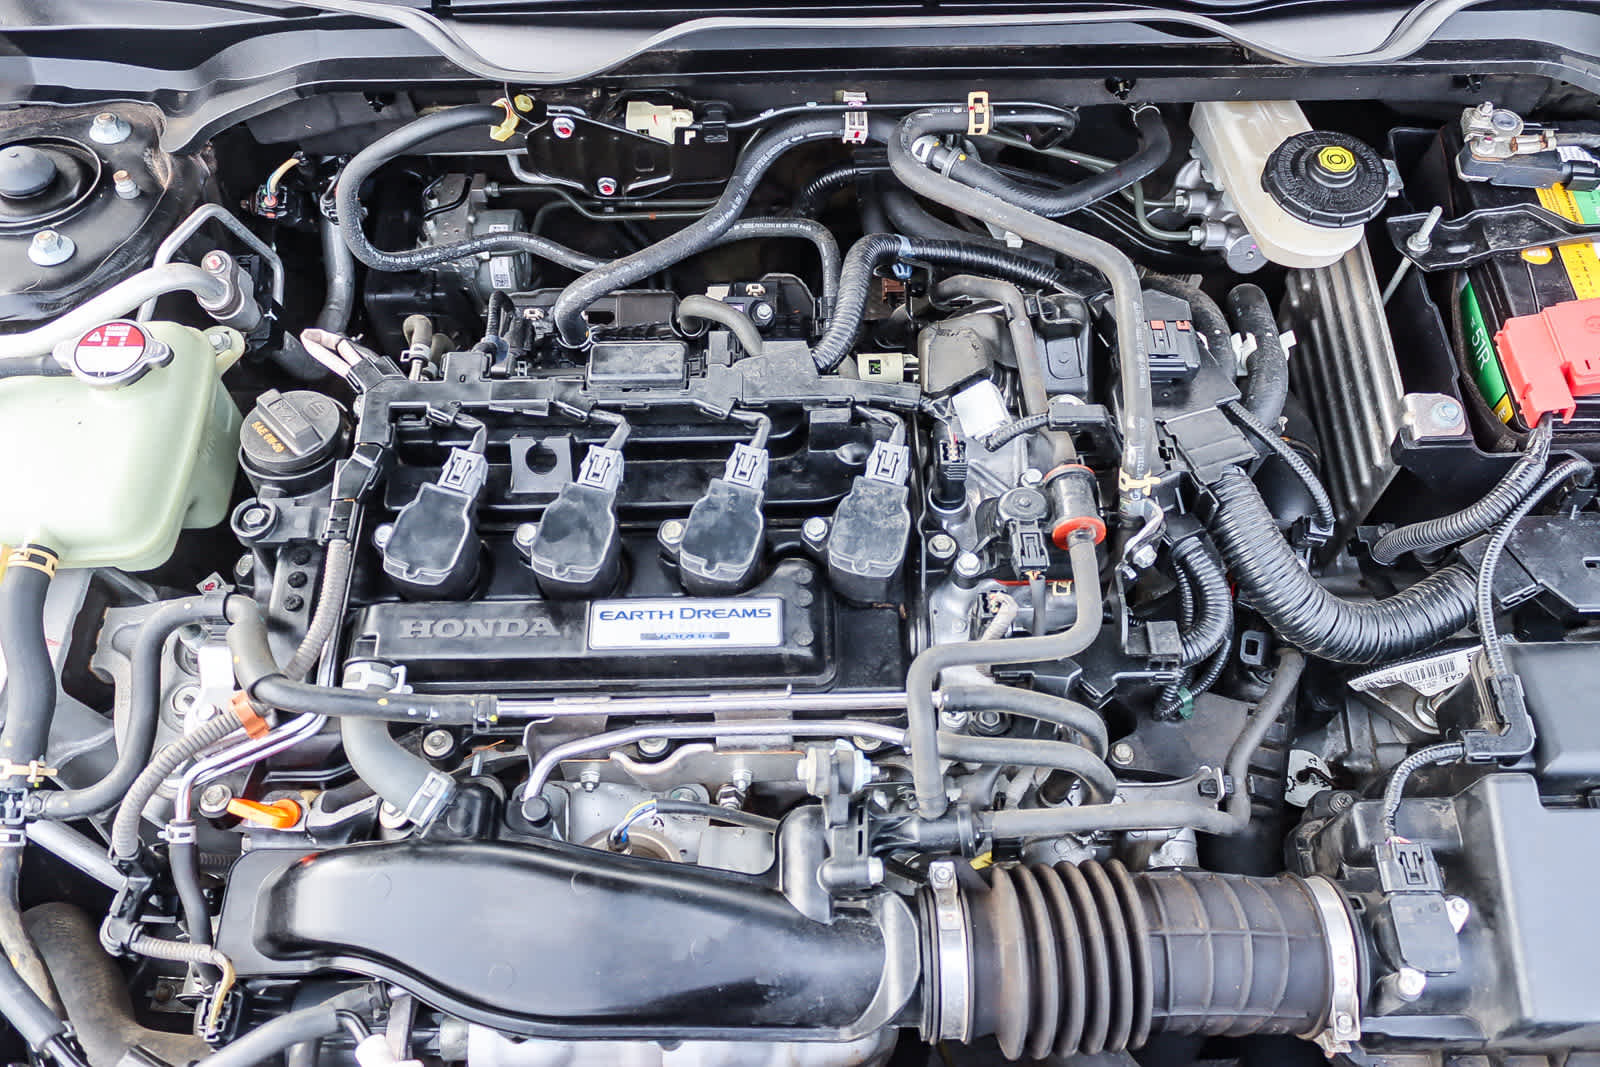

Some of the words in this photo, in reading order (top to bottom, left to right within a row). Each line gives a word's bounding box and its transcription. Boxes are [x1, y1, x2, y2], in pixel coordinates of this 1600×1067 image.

[1472, 327, 1491, 370] 51R
[599, 610, 674, 621] EARTH
[679, 607, 773, 619] DREAMS
[399, 616, 561, 639] HONDA
